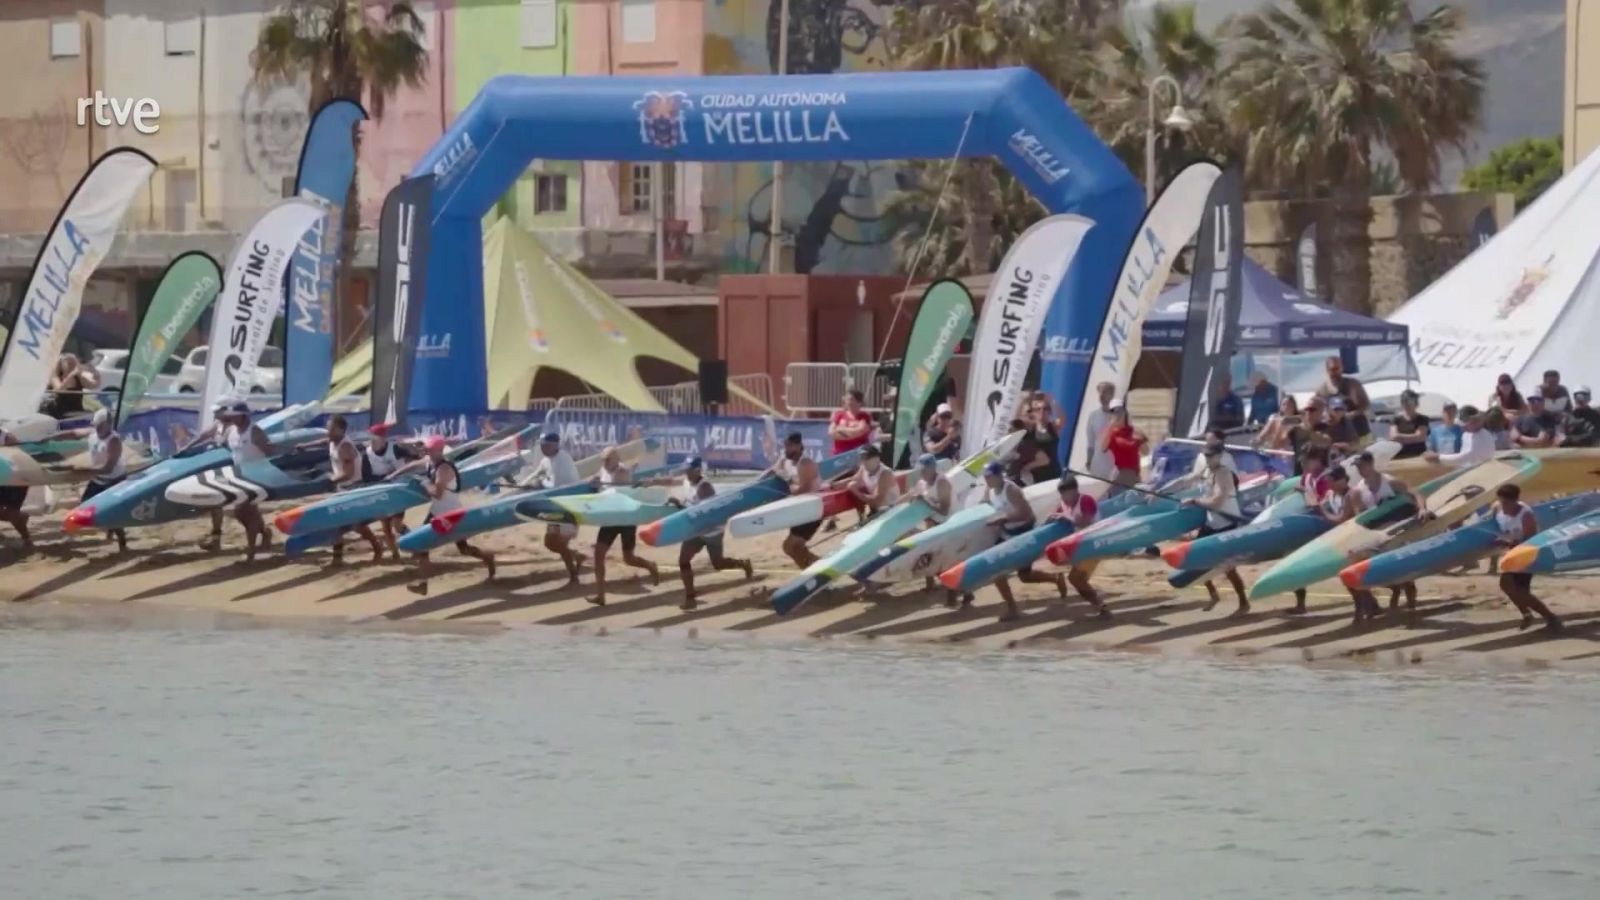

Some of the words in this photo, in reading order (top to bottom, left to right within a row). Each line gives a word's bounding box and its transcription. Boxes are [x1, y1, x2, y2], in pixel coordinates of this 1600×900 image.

[700, 94, 756, 108] CIUDAD
[758, 91, 847, 107] AUTÓNOMA
[702, 110, 850, 144] MELILLA
[17, 218, 92, 361] MELILLA
[162, 275, 214, 342] iberdrola
[229, 239, 270, 353] SURFING
[1102, 225, 1167, 374] MELILLA
[923, 302, 967, 372] iberdrola
[992, 265, 1034, 387] SURFING
[1408, 336, 1516, 369] MELILLA
[704, 425, 753, 449] MELILLA
